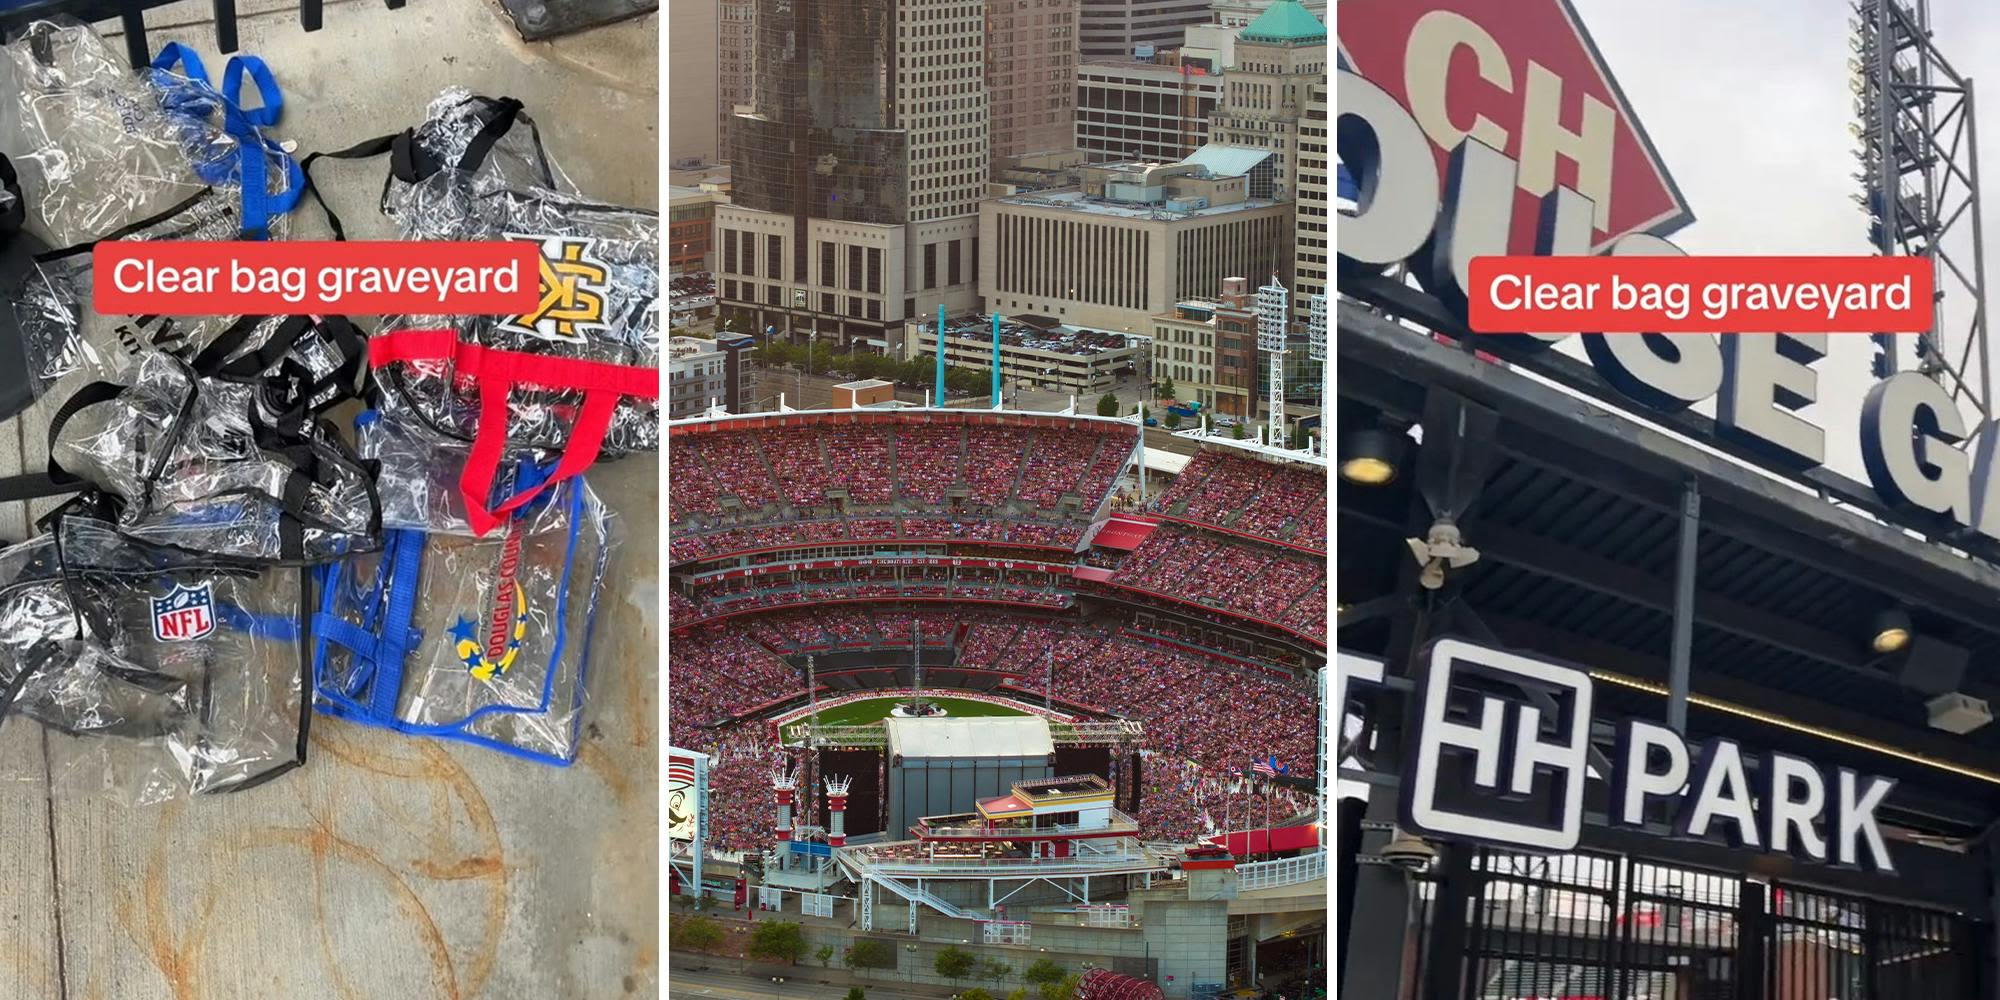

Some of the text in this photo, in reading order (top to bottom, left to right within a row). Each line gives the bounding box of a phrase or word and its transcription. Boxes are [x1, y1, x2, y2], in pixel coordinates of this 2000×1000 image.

[1404, 10, 1617, 233] CH
[1864, 369, 2000, 541] G
[160, 608, 210, 637] NFL
[486, 581, 515, 659] DOUGLAS
[1623, 720, 1894, 872] PARK
